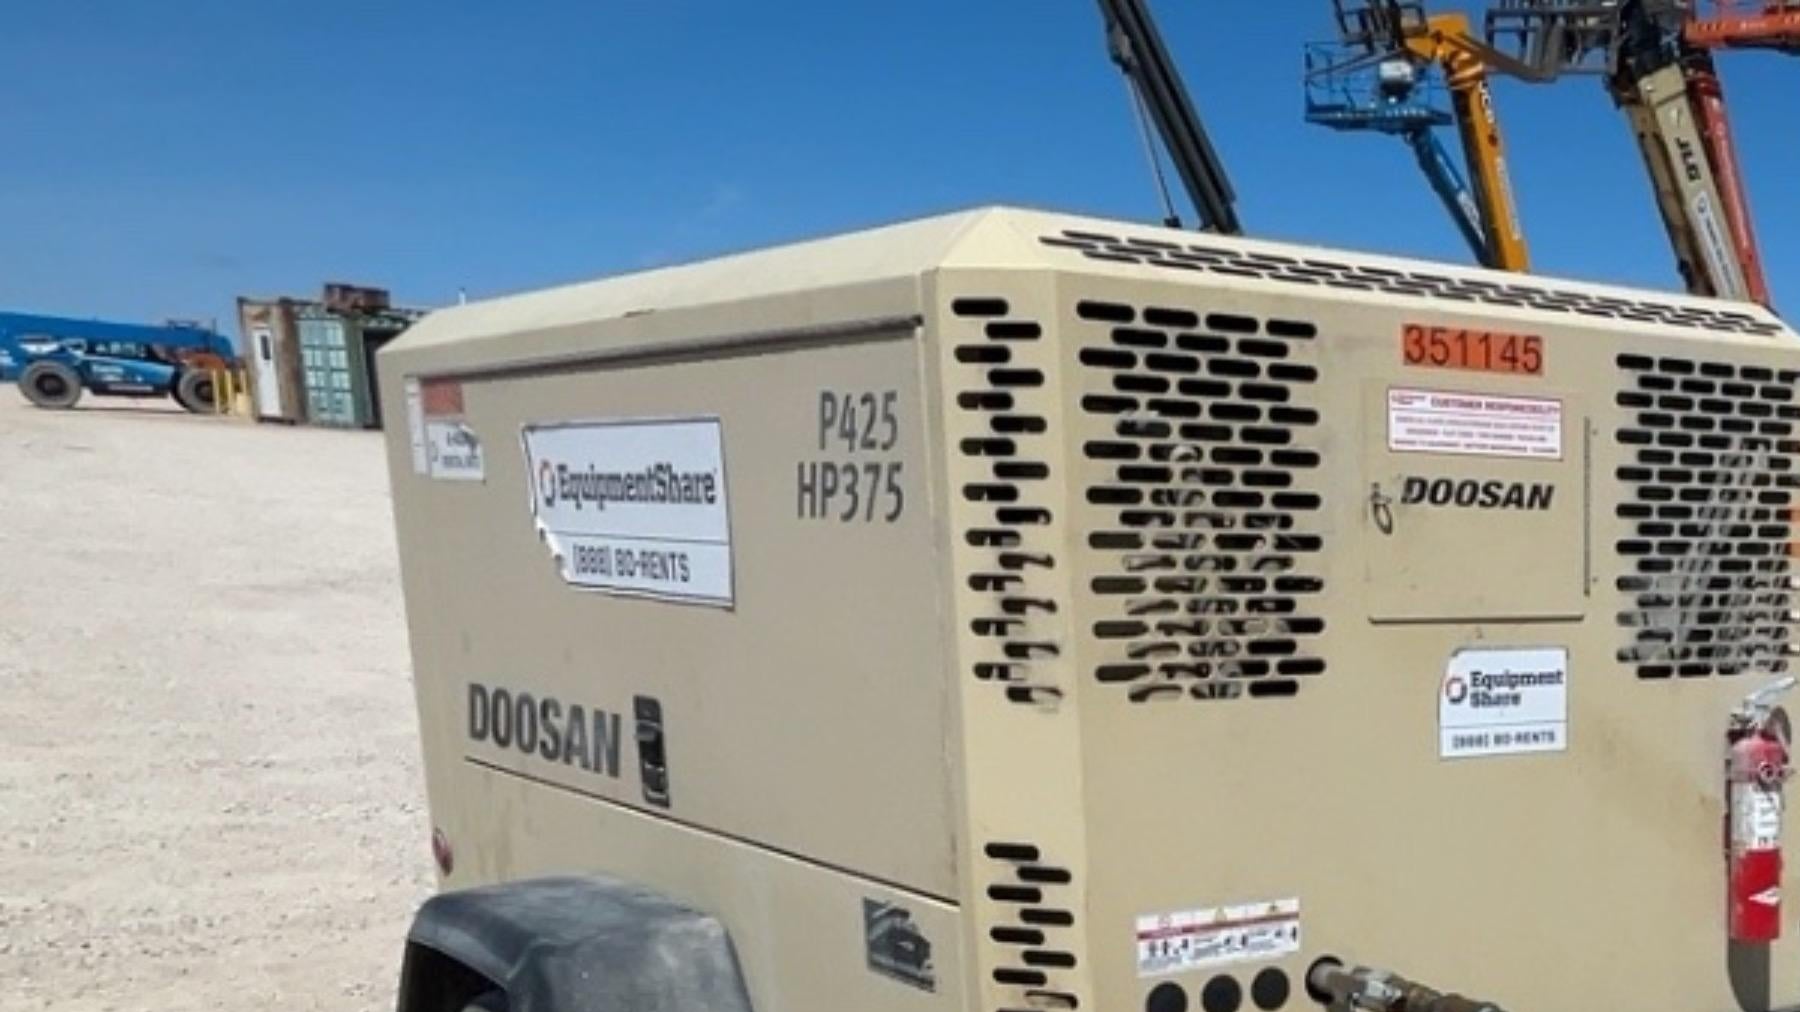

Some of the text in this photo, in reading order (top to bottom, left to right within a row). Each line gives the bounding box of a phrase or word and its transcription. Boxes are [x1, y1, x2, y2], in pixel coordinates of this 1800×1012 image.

[1675, 137, 1702, 182] JLG
[1403, 324, 1543, 374] 351145
[818, 391, 897, 451] P425
[557, 463, 715, 511] EquipmentShare
[797, 461, 903, 522] HP375
[1401, 476, 1554, 510] DOOSAN
[1470, 669, 1563, 690] Equipment
[1470, 691, 1520, 708] Share
[468, 683, 620, 779] DOOSAN
